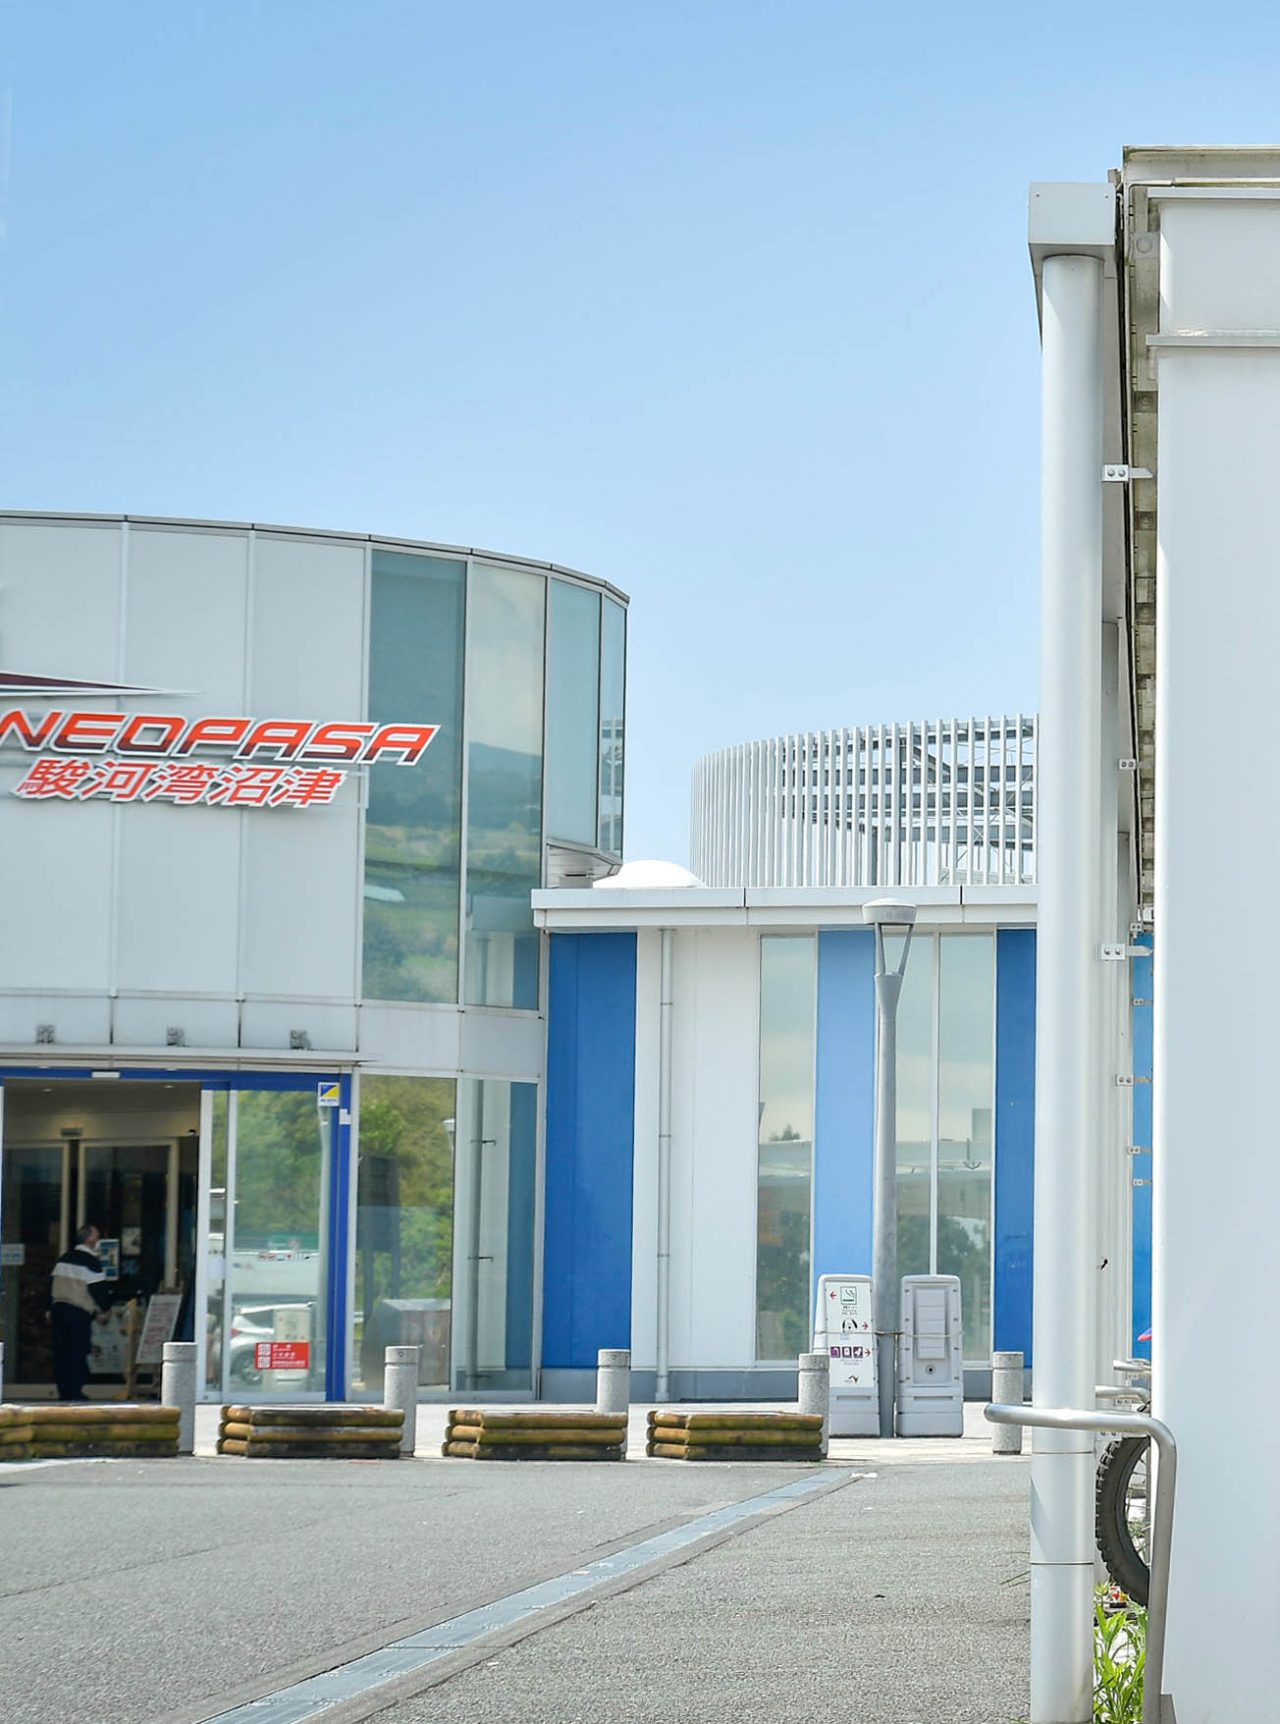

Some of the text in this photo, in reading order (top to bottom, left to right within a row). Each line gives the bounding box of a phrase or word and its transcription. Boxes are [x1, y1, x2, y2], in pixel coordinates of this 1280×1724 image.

[0, 709, 441, 766] NEOPASA
[12, 756, 348, 808] 駿河湾沼津
